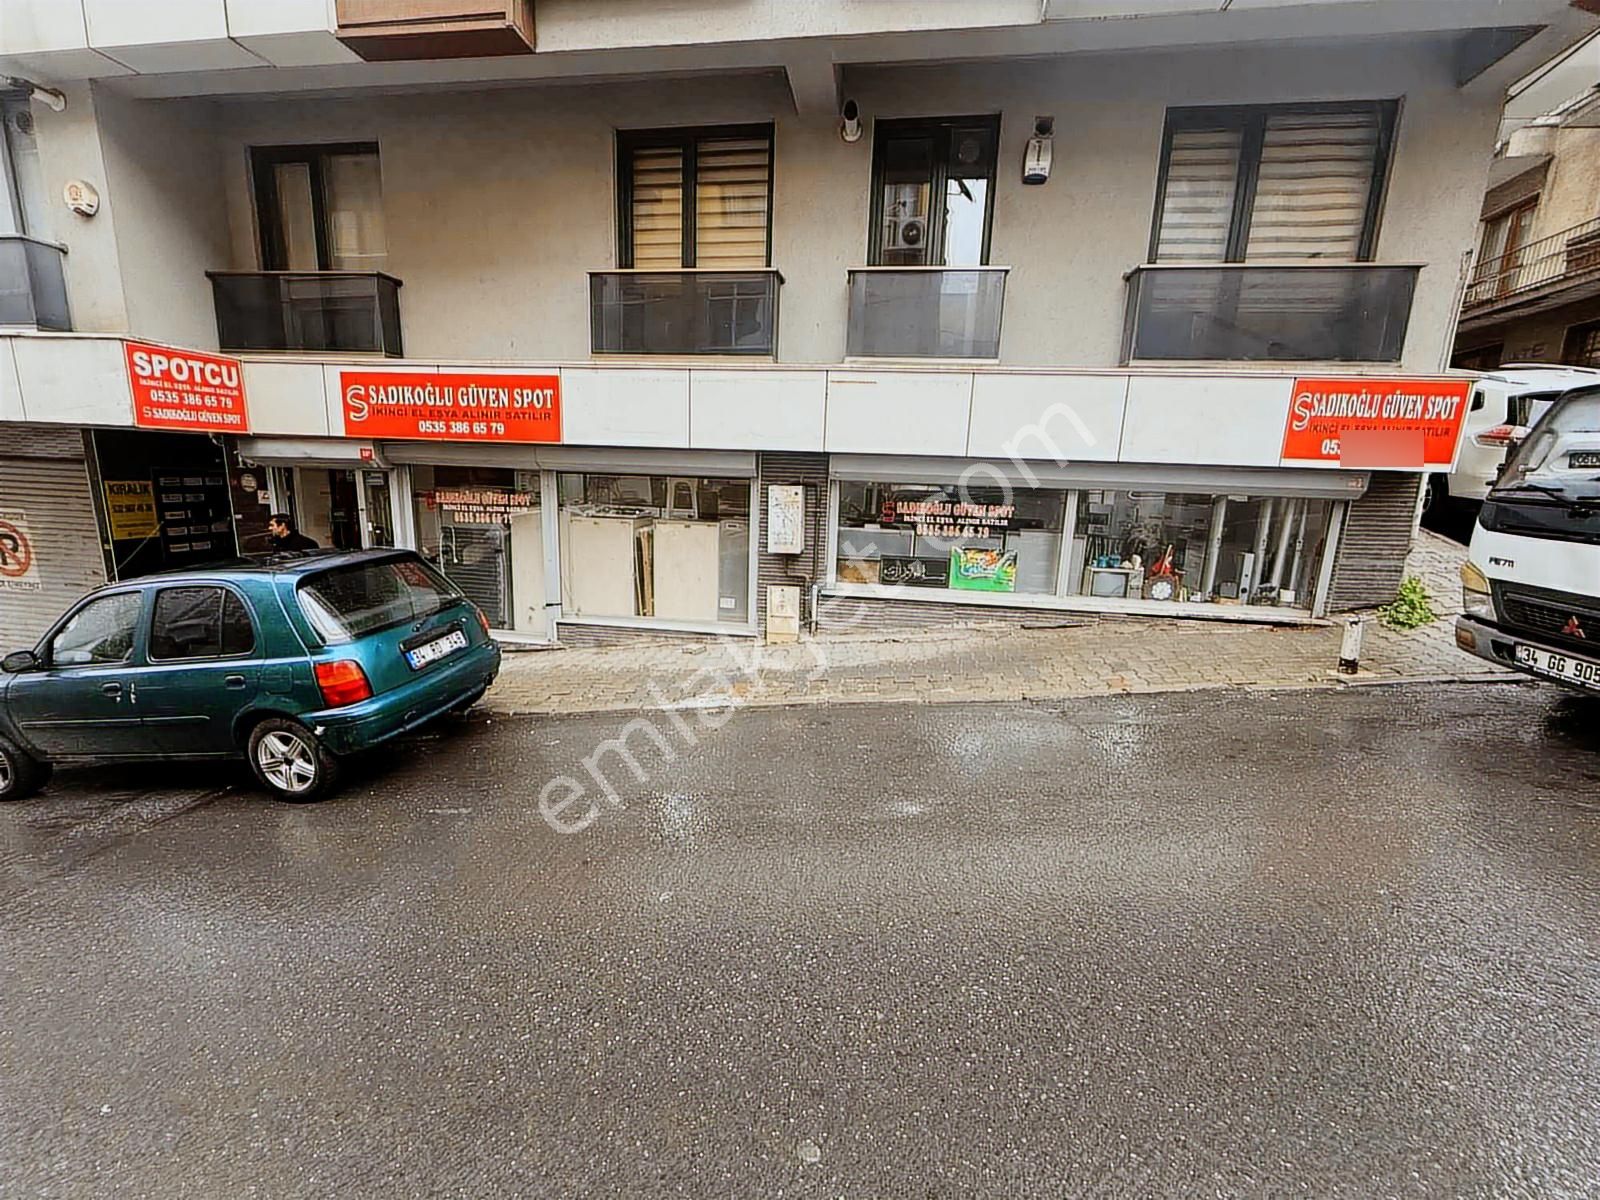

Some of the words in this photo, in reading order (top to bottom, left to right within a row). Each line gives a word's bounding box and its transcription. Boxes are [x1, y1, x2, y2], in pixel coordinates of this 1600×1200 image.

[133, 351, 239, 388] SPOTCU
[150, 389, 179, 403] 0535
[182, 392, 202, 406] 386
[204, 395, 218, 407] 65
[220, 397, 233, 409] 79
[369, 383, 453, 406] SADIKOĞLU
[458, 384, 509, 408] GÜVEN
[514, 388, 554, 409] SPOT
[1311, 389, 1382, 417] SADIKOĞLU
[1382, 390, 1426, 420] GÜVEN
[1424, 396, 1460, 420] SPOT
[153, 407, 197, 421] SADIKOĞLU
[198, 410, 222, 423] GÜVEN
[223, 414, 241, 425] SPOT
[371, 404, 408, 417] İKİNCİ
[411, 408, 424, 418] EL
[428, 409, 458, 421] EŞYA
[462, 410, 501, 421] ALINIR
[504, 411, 552, 421] SATILIR
[418, 420, 446, 433] 0535
[449, 421, 470, 433] 386
[473, 421, 487, 434] 65
[490, 422, 505, 435] 79
[108, 483, 151, 496] KIRALIK
[510, 494, 531, 506] SPOT
[896, 500, 952, 516] SADIKOĞLU
[953, 502, 986, 516] GÜVEN
[988, 505, 1014, 518] SPOT
[961, 526, 975, 538] 65
[1522, 647, 1538, 664] 34
[1547, 654, 1566, 673] GG
[1574, 662, 1600, 683] 905
